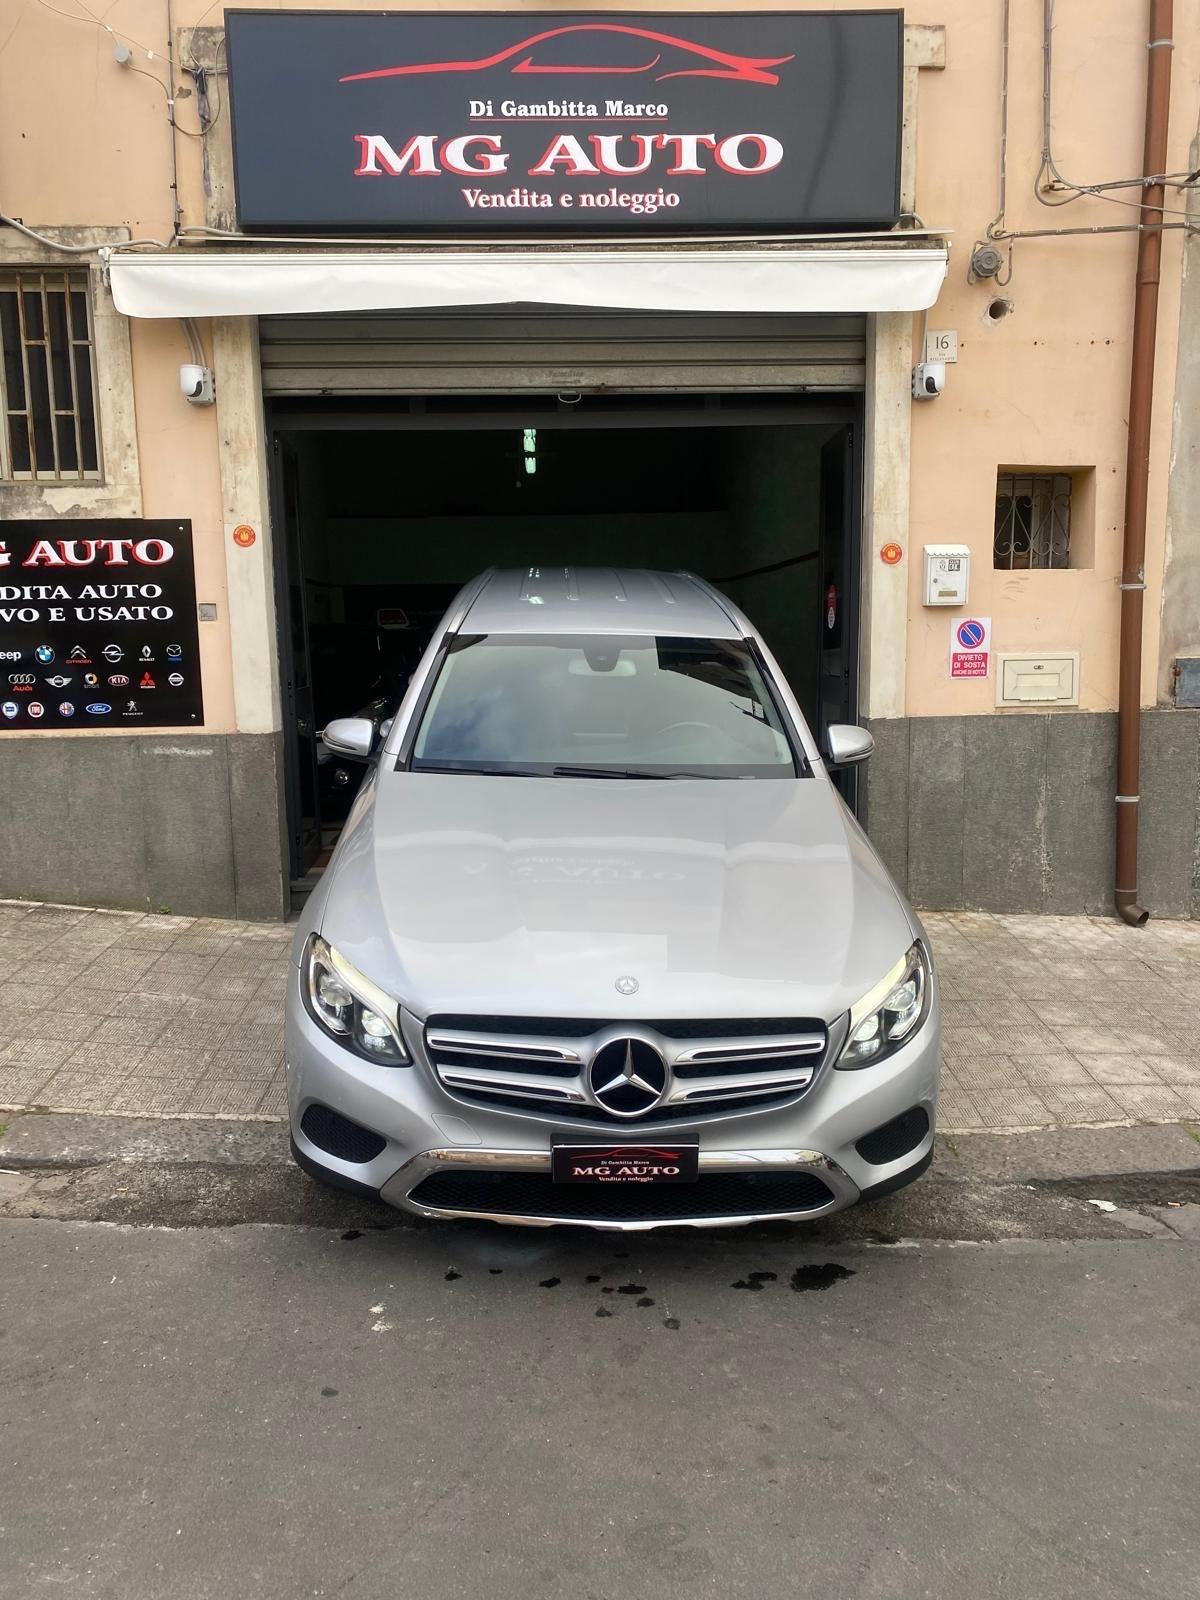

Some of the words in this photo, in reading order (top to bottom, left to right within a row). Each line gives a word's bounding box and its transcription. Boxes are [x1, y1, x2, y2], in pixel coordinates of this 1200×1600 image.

[469, 101, 494, 117] Di
[500, 101, 599, 117] Gambitta
[604, 101, 669, 117] Marco
[354, 134, 510, 176] MG
[528, 133, 784, 176] AUTO
[463, 188, 554, 208] Vendita
[560, 192, 573, 208] e
[579, 188, 680, 214] noleggio
[936, 335, 949, 350] 16
[22, 538, 174, 567] AUTO
[78, 584, 163, 600] AUTO
[48, 607, 66, 622] E
[74, 606, 174, 621] USATO
[963, 661, 986, 669] SOSTA
[572, 1167, 611, 1175] MG
[616, 1166, 680, 1175] AUTO
